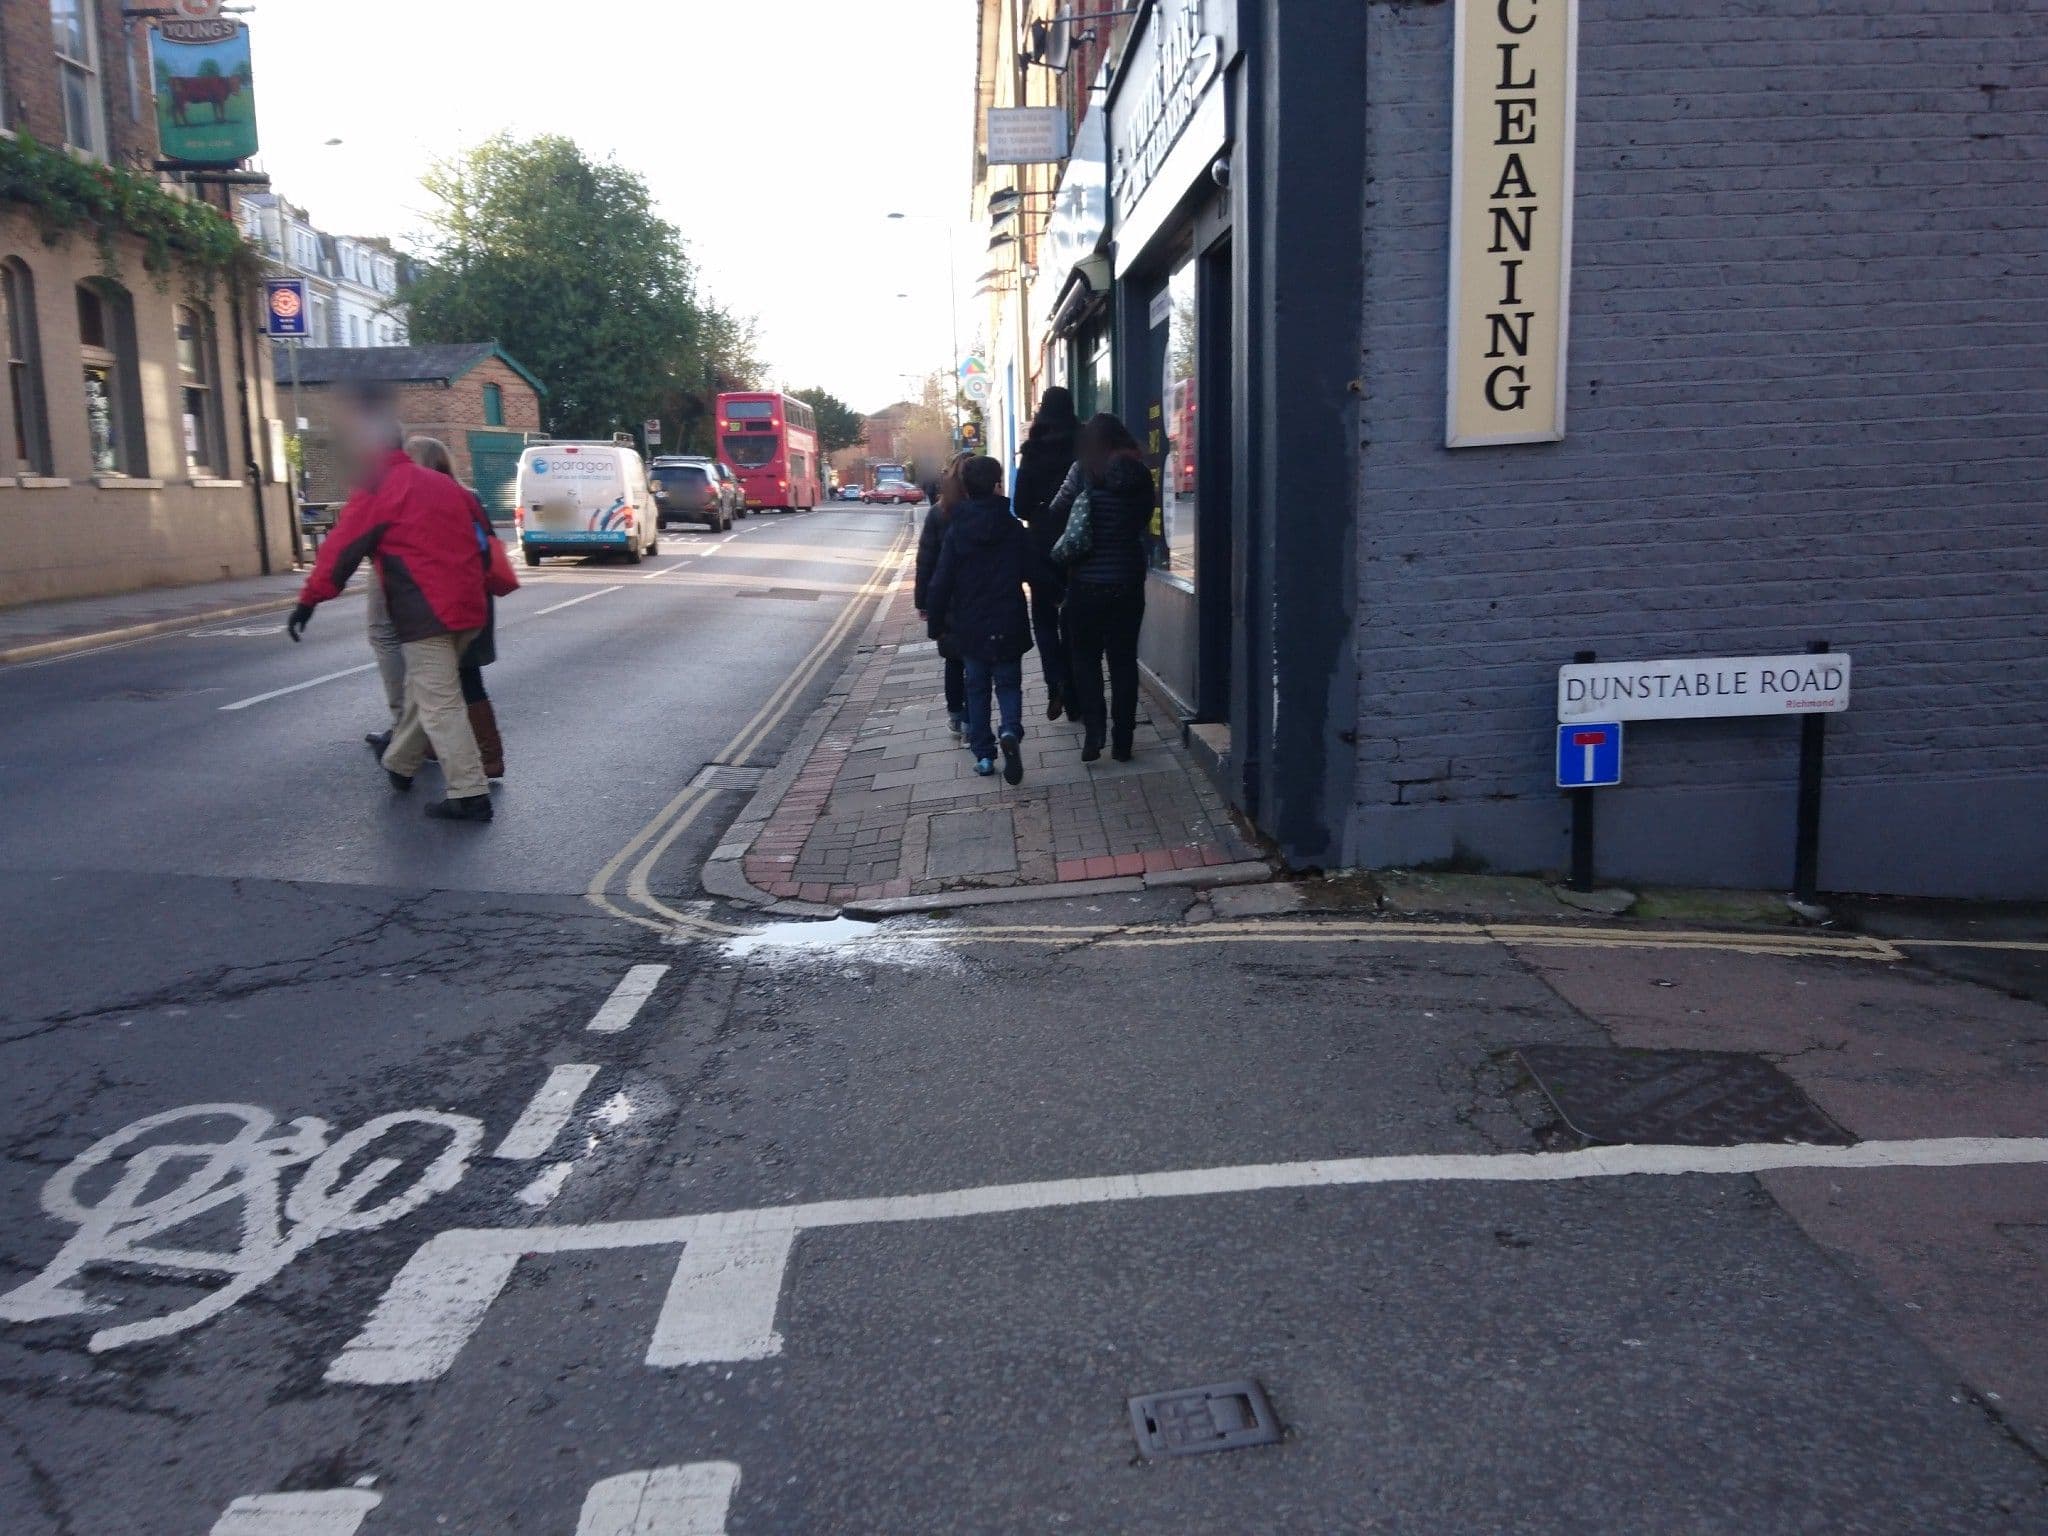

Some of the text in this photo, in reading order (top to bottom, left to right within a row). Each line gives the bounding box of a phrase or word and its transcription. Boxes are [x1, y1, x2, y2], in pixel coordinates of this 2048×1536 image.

[1483, 0, 1538, 412] CLEANING
[551, 460, 613, 474] paragon
[1566, 667, 1843, 701] DUNSTABLE ROAD
[1786, 699, 1835, 708] Richmond
